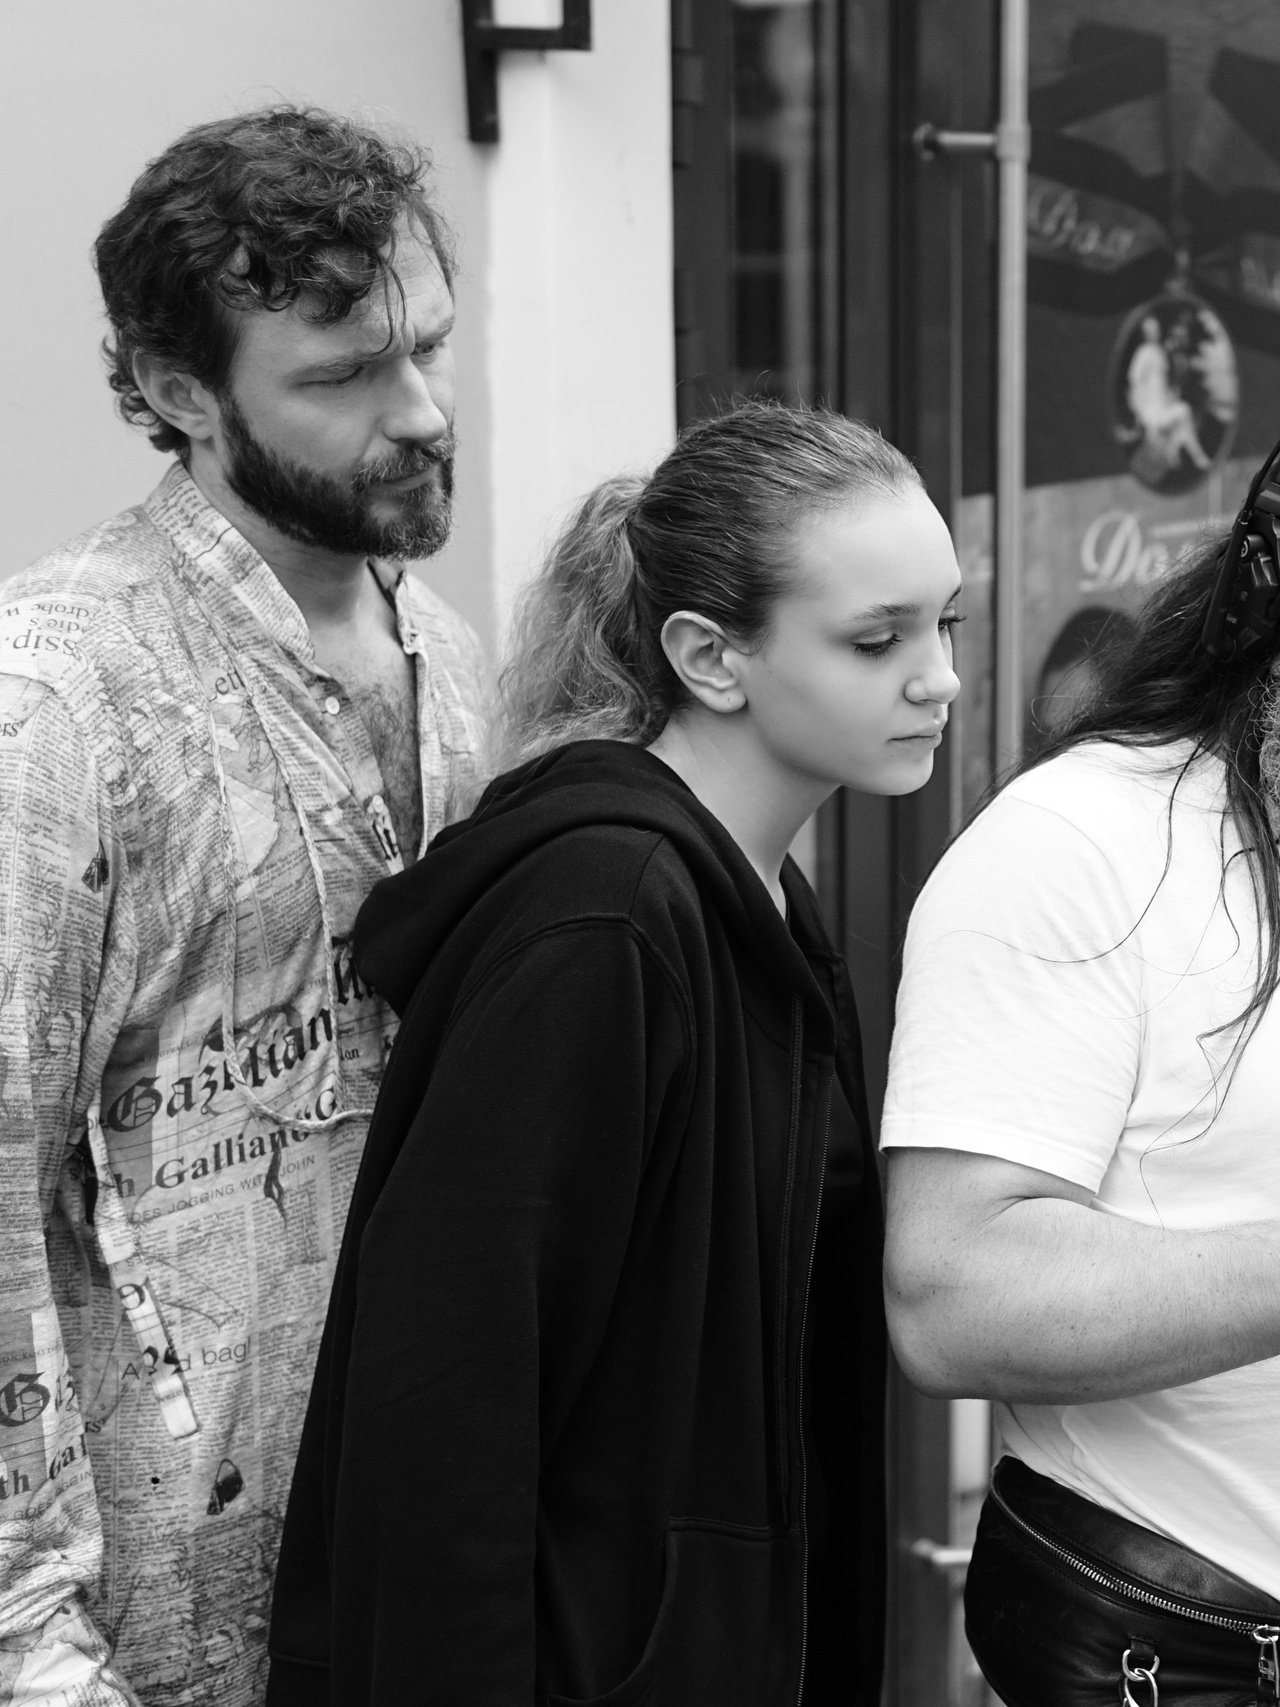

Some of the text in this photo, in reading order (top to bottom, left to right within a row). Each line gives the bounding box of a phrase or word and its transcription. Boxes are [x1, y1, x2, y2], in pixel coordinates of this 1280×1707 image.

[168, 1184, 236, 1214] JOGGING
[239, 1172, 270, 1191] WIT
[279, 1155, 316, 1178] JOHN
